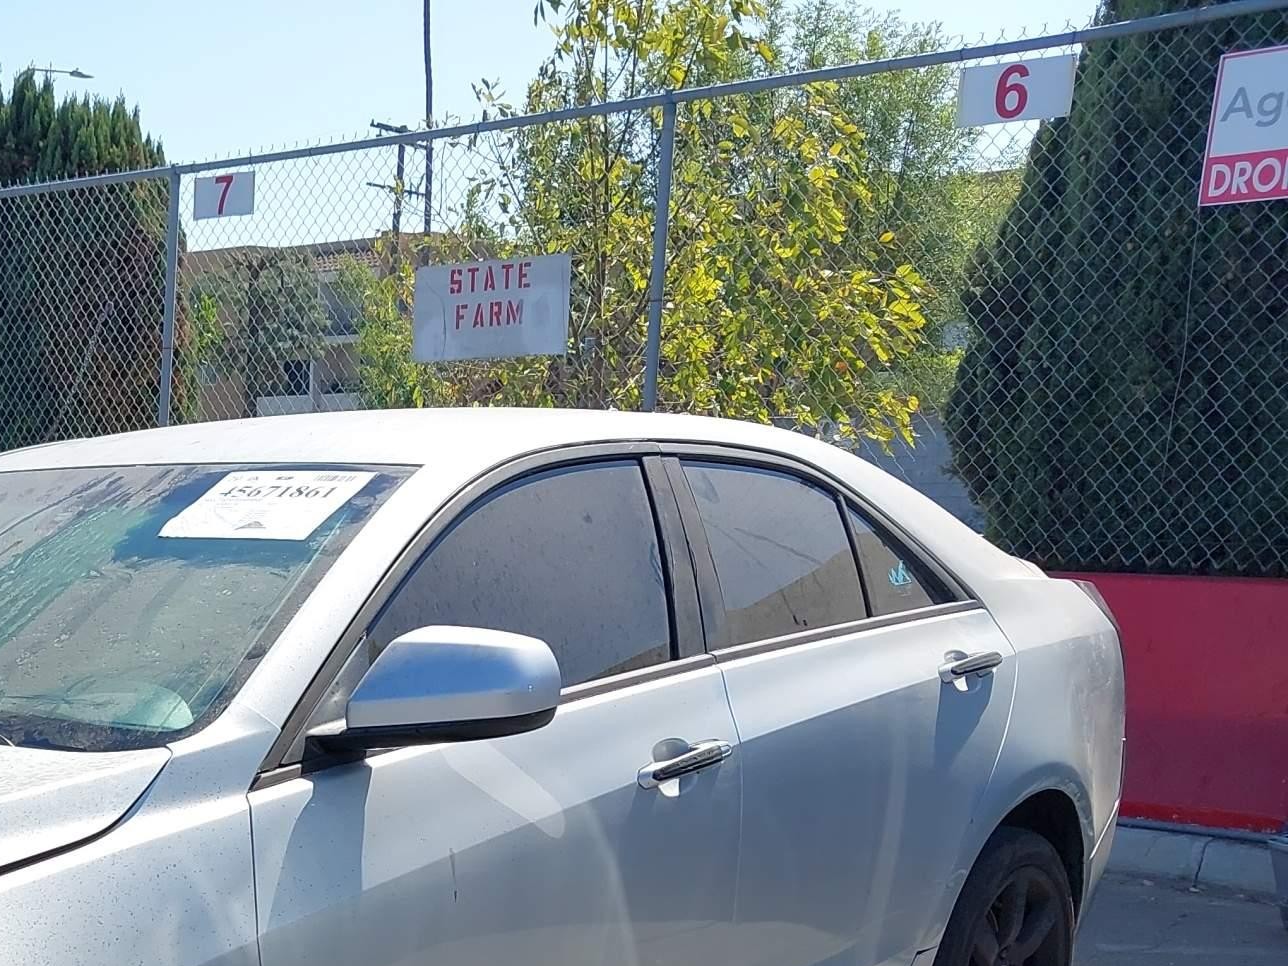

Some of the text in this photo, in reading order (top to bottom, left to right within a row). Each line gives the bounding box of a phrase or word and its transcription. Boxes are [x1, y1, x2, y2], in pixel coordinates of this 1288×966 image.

[994, 63, 1031, 120] 6
[1220, 86, 1288, 128] Ag
[215, 175, 234, 216] 7
[449, 262, 532, 295] STATE
[455, 299, 524, 330] FARM
[219, 485, 338, 499] 45671861
